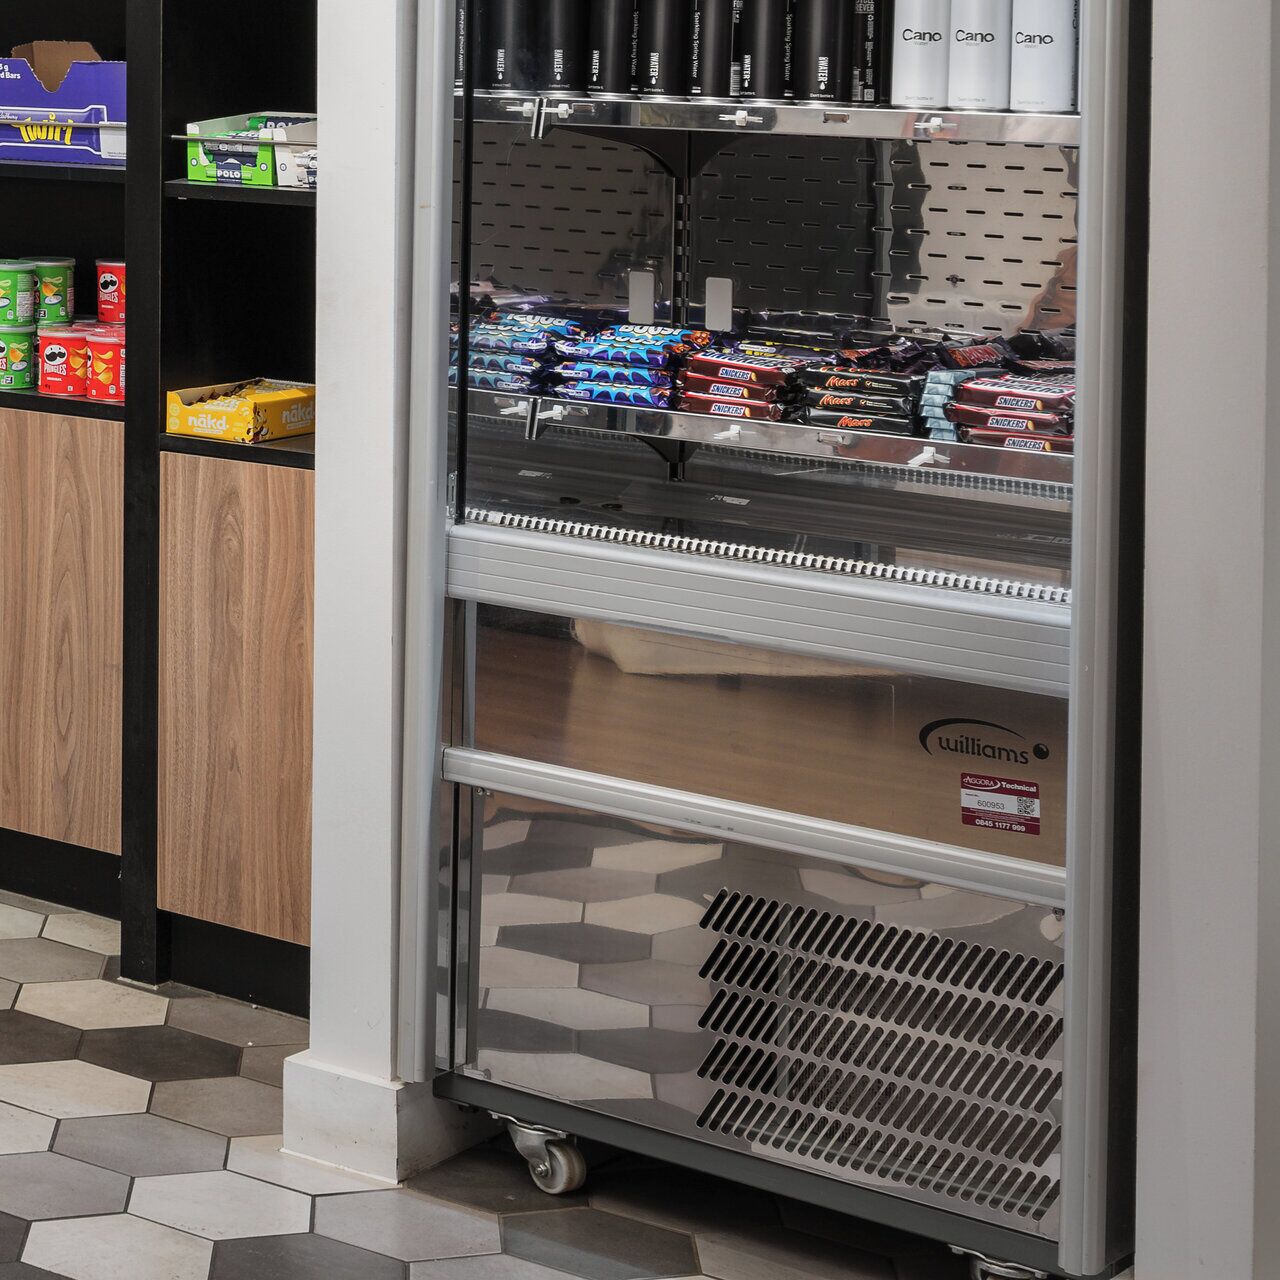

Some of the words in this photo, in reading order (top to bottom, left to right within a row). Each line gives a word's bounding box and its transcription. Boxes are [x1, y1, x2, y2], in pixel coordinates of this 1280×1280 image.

[902, 29, 942, 42] Cano
[956, 30, 994, 42] Cano
[1016, 32, 1053, 45] Cano
[11, 112, 74, 145] Twirl
[217, 170, 240, 178] POLO
[44, 363, 66, 375] PRINGLES
[720, 369, 750, 379] SNICKERS
[826, 376, 859, 387] Mars
[711, 385, 742, 395] SNICKERS
[820, 394, 853, 405] Mars
[998, 397, 1034, 408] SNICKERS
[713, 405, 743, 415] SNICKERS
[837, 416, 872, 427] Mars
[989, 418, 1026, 428] SNICKERS
[1006, 438, 1042, 449] SNICKERS
[938, 735, 1029, 765] williams
[963, 776, 995, 786] AGGORA
[1001, 782, 1037, 792] Technical
[977, 800, 1005, 810] 600953
[975, 819, 993, 827] 0845
